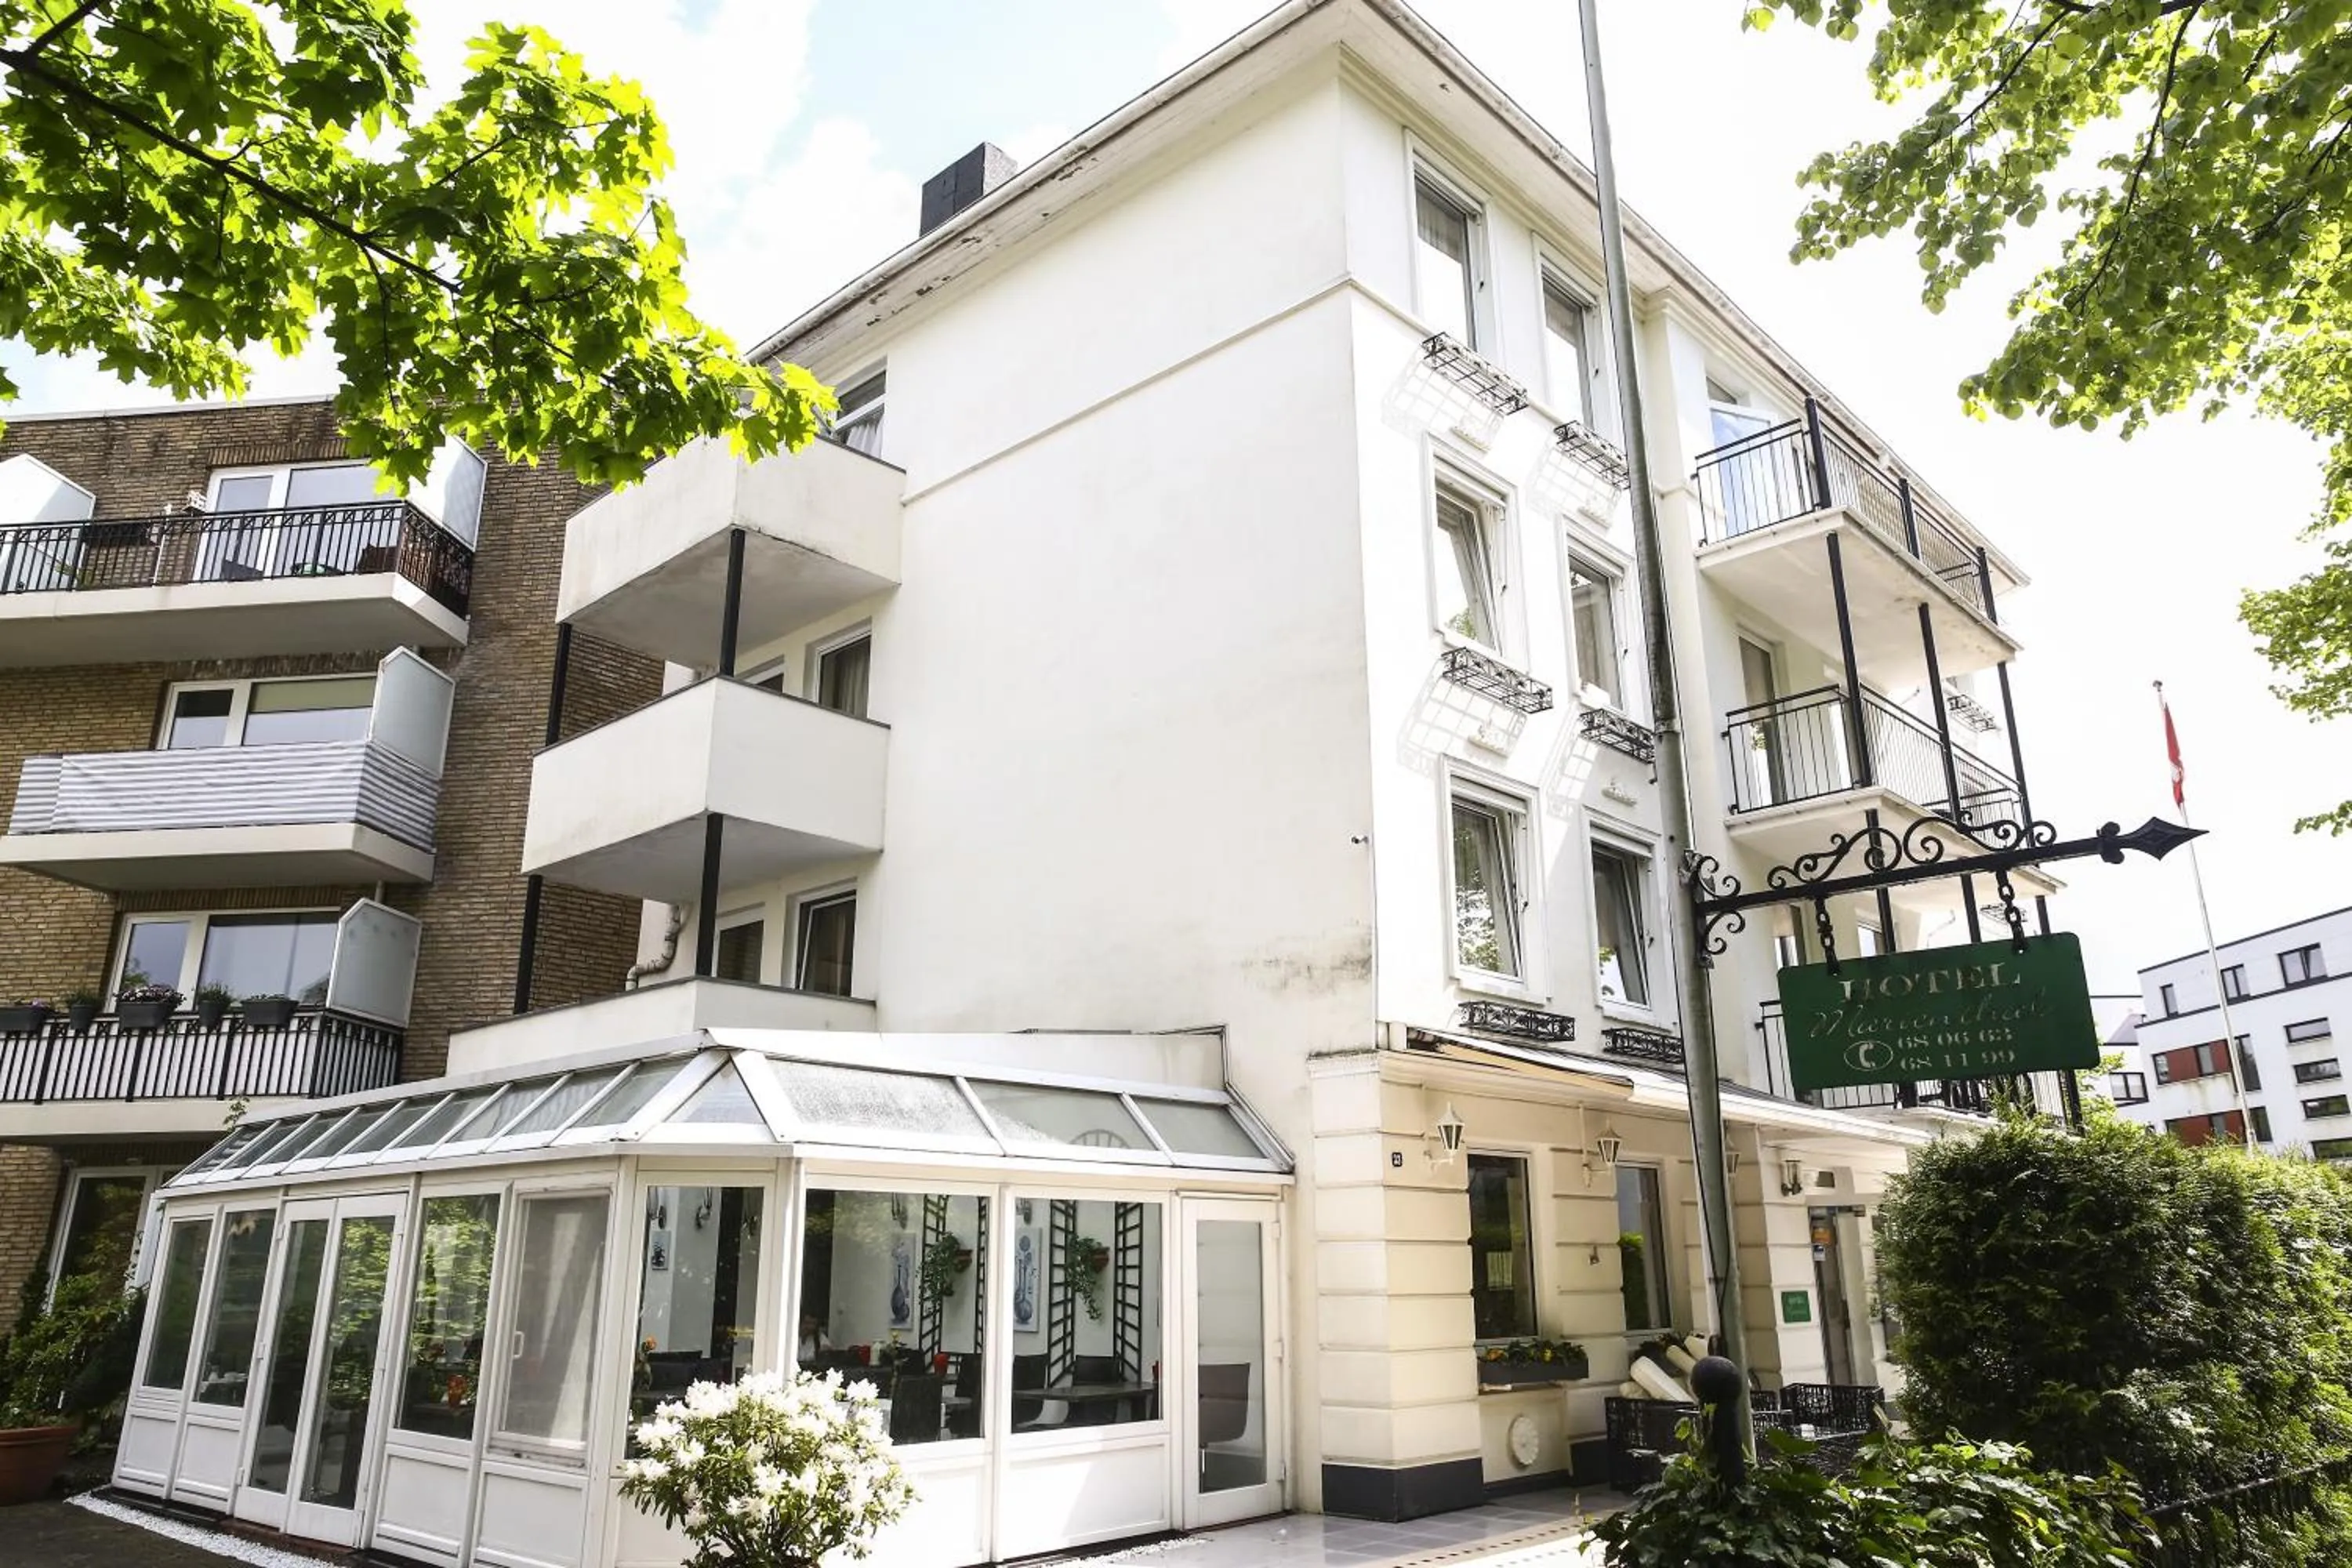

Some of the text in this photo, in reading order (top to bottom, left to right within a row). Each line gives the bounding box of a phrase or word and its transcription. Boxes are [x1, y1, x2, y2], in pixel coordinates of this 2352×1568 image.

[1839, 962, 2021, 1003] HOTEL
[1897, 1034, 1929, 1049] 68
[1936, 1031, 1969, 1047] 06
[1900, 1049, 2016, 1072] 68 11 99
